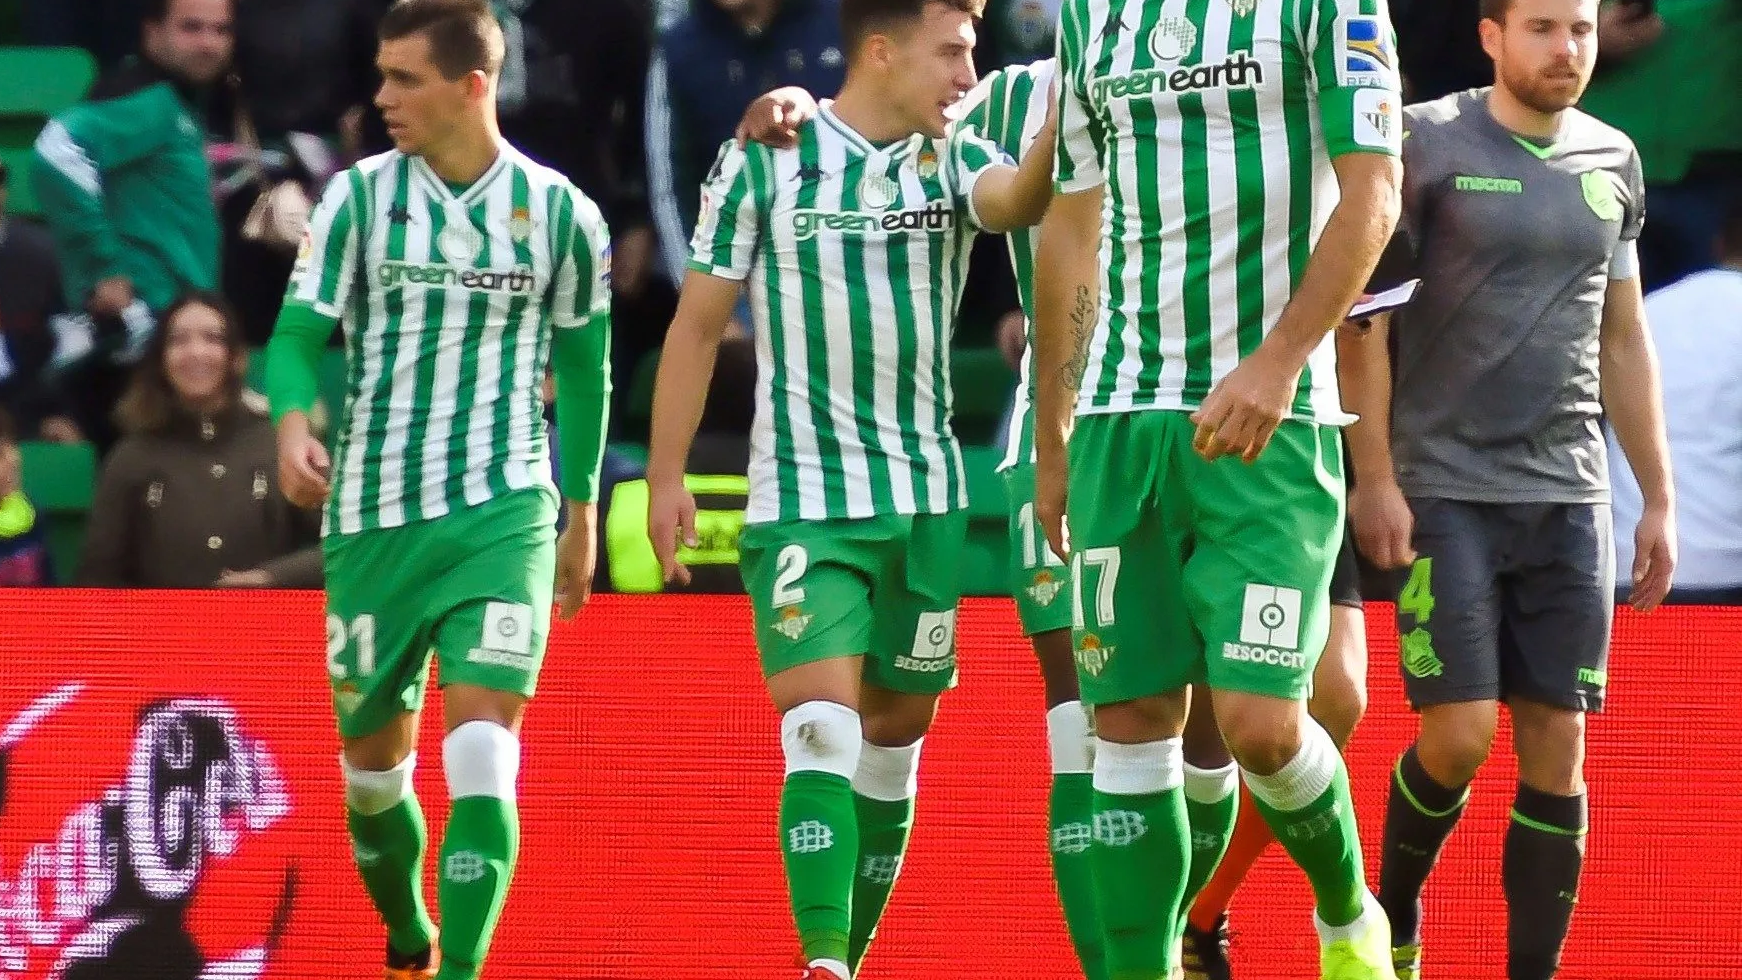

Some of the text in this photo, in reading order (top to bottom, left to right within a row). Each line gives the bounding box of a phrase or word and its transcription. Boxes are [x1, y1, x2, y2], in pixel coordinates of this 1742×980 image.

[1092, 53, 1263, 113] green earth
[793, 202, 952, 236] green earth
[380, 264, 535, 292] green earth
[772, 544, 808, 609] 2
[1071, 546, 1120, 630] 17
[1399, 557, 1434, 623] 4
[325, 613, 376, 679] 21
